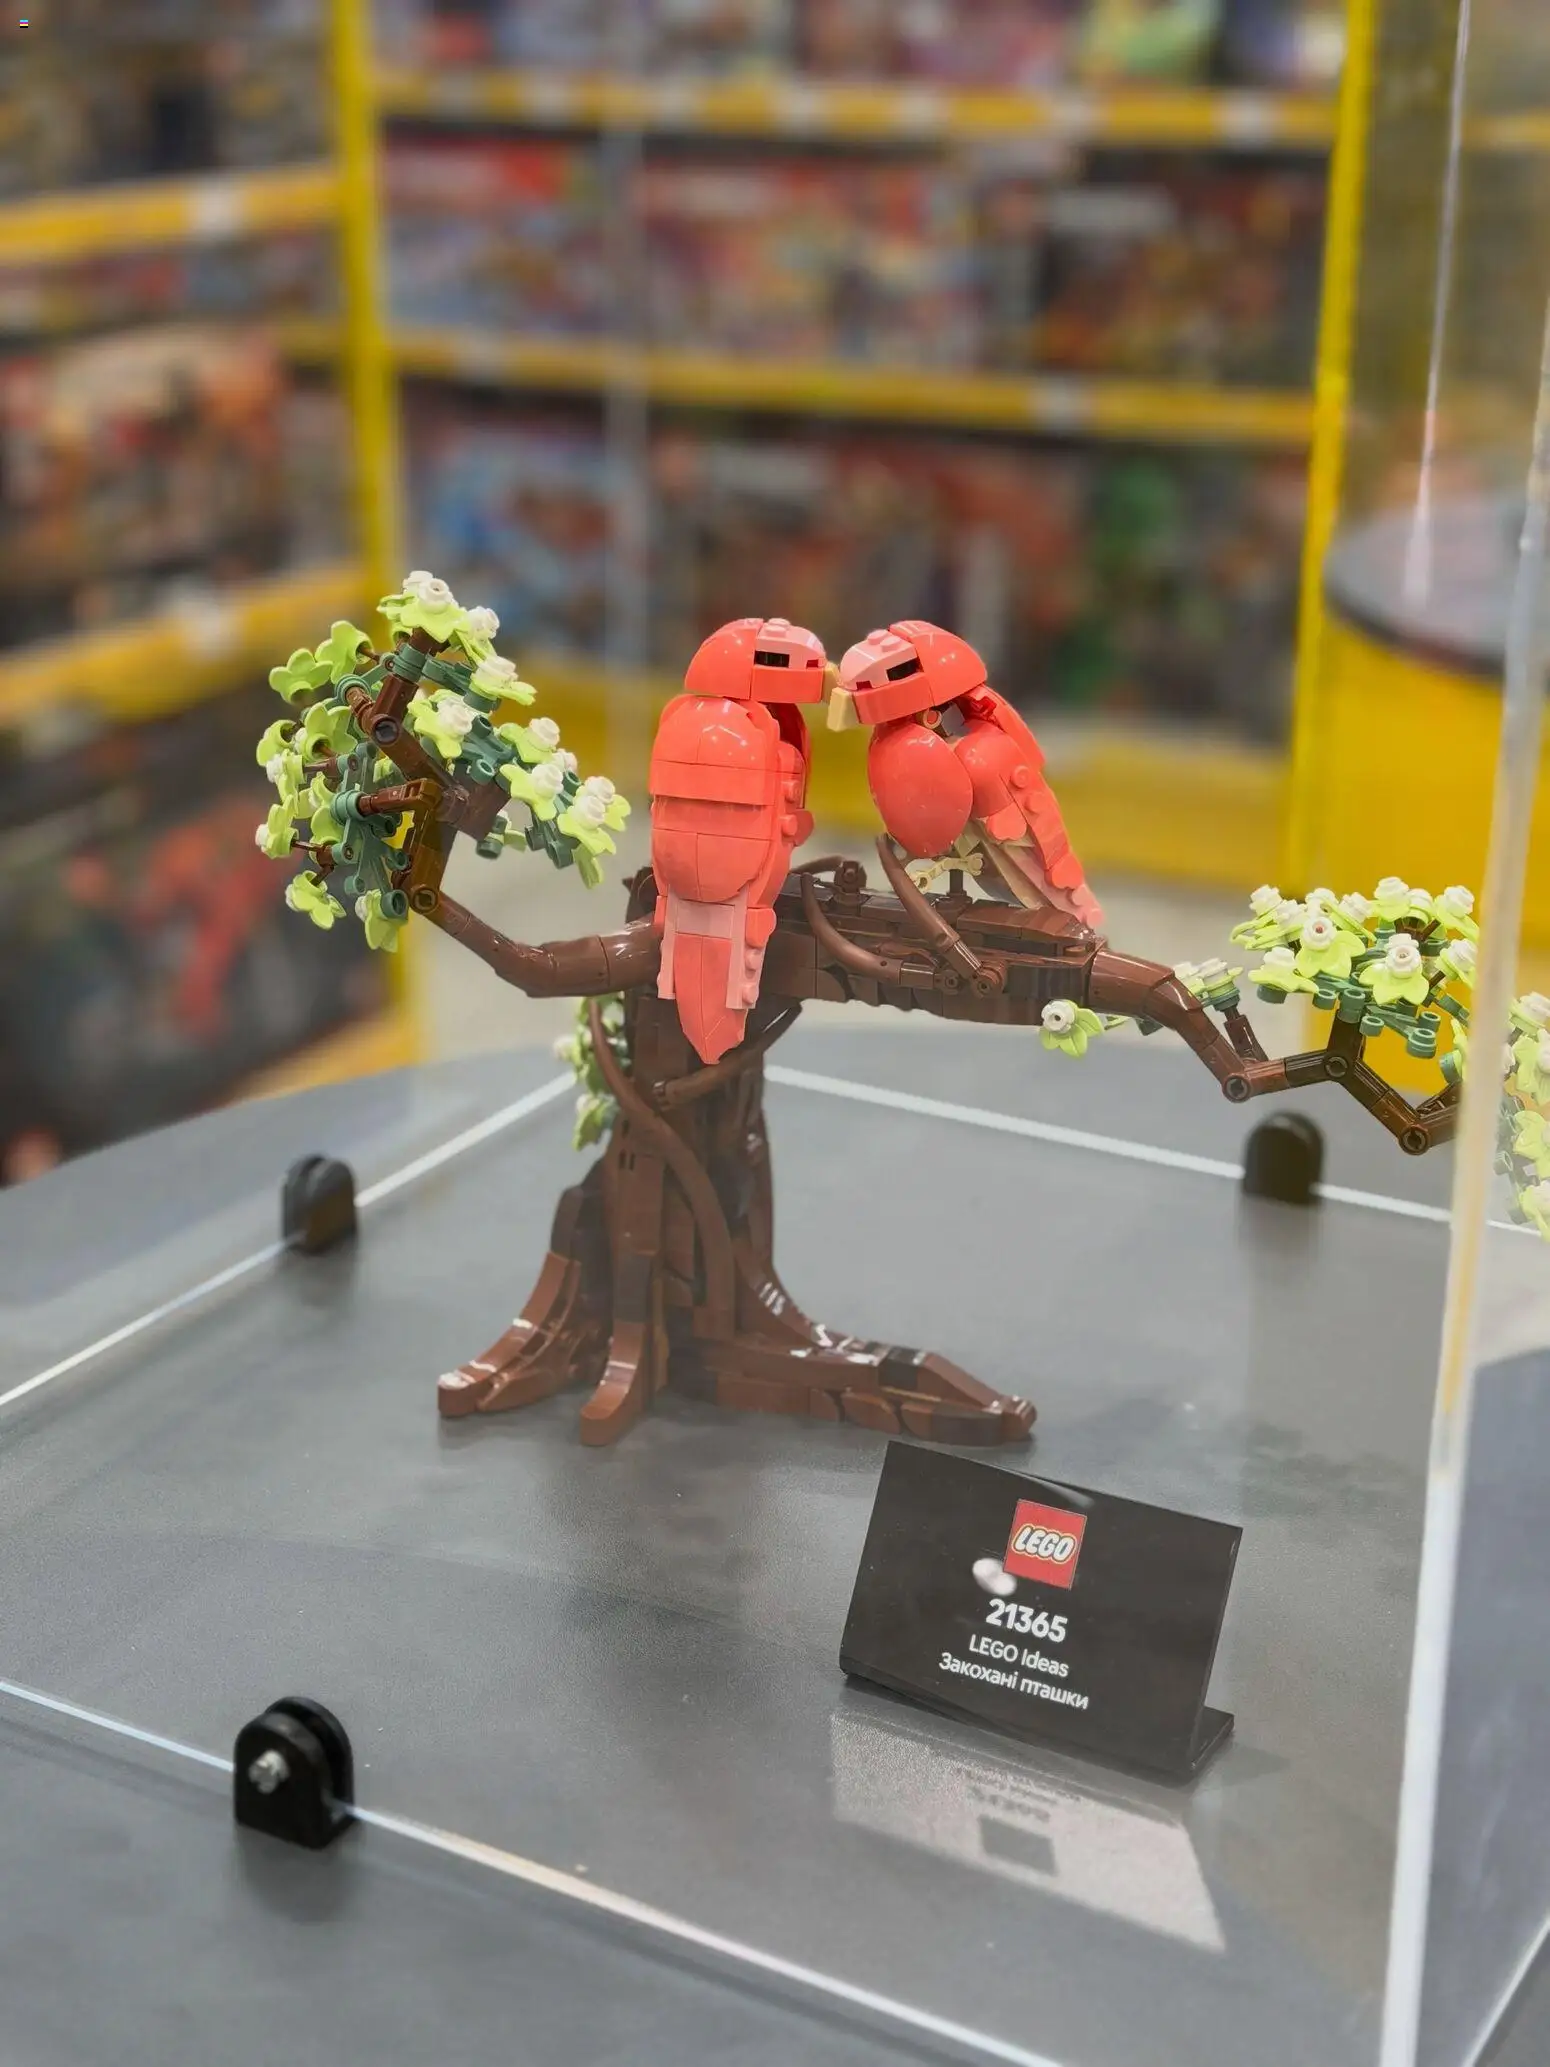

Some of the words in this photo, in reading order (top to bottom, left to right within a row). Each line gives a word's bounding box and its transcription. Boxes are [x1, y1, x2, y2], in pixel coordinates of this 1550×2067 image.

[1013, 1524, 1076, 1563] LEGO
[986, 1598, 1068, 1643] 21365
[969, 1633, 1018, 1662] LEGO
[1021, 1648, 1069, 1678] Ideas
[938, 1652, 1018, 1689] Закохані
[1020, 1677, 1090, 1710] пташки
